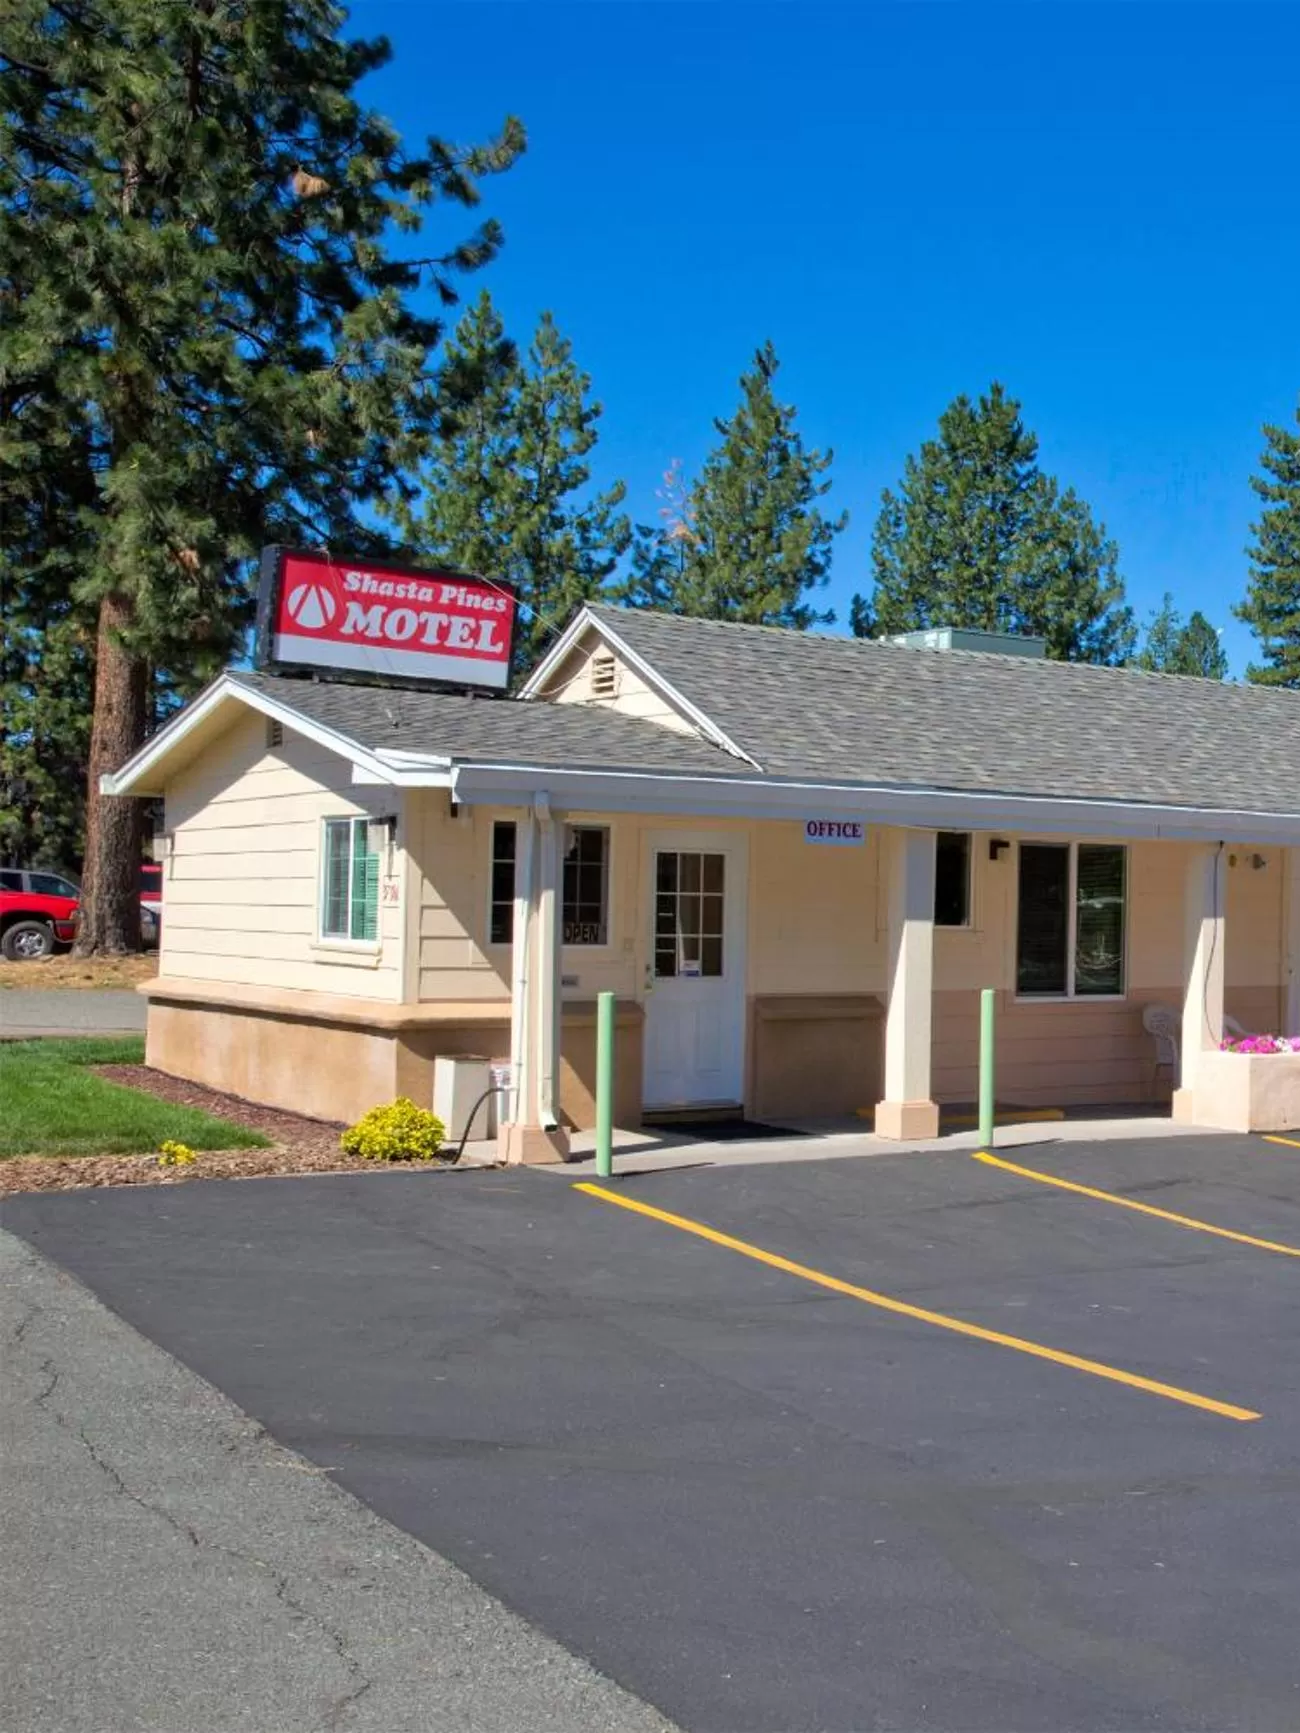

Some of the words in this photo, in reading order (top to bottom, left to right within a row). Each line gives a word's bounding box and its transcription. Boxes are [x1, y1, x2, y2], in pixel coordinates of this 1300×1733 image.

[343, 571, 433, 602] Shasta
[440, 584, 507, 612] Pines
[340, 601, 503, 653] MOTEL
[806, 820, 862, 838] OFFICE
[564, 924, 600, 942] OPEN
